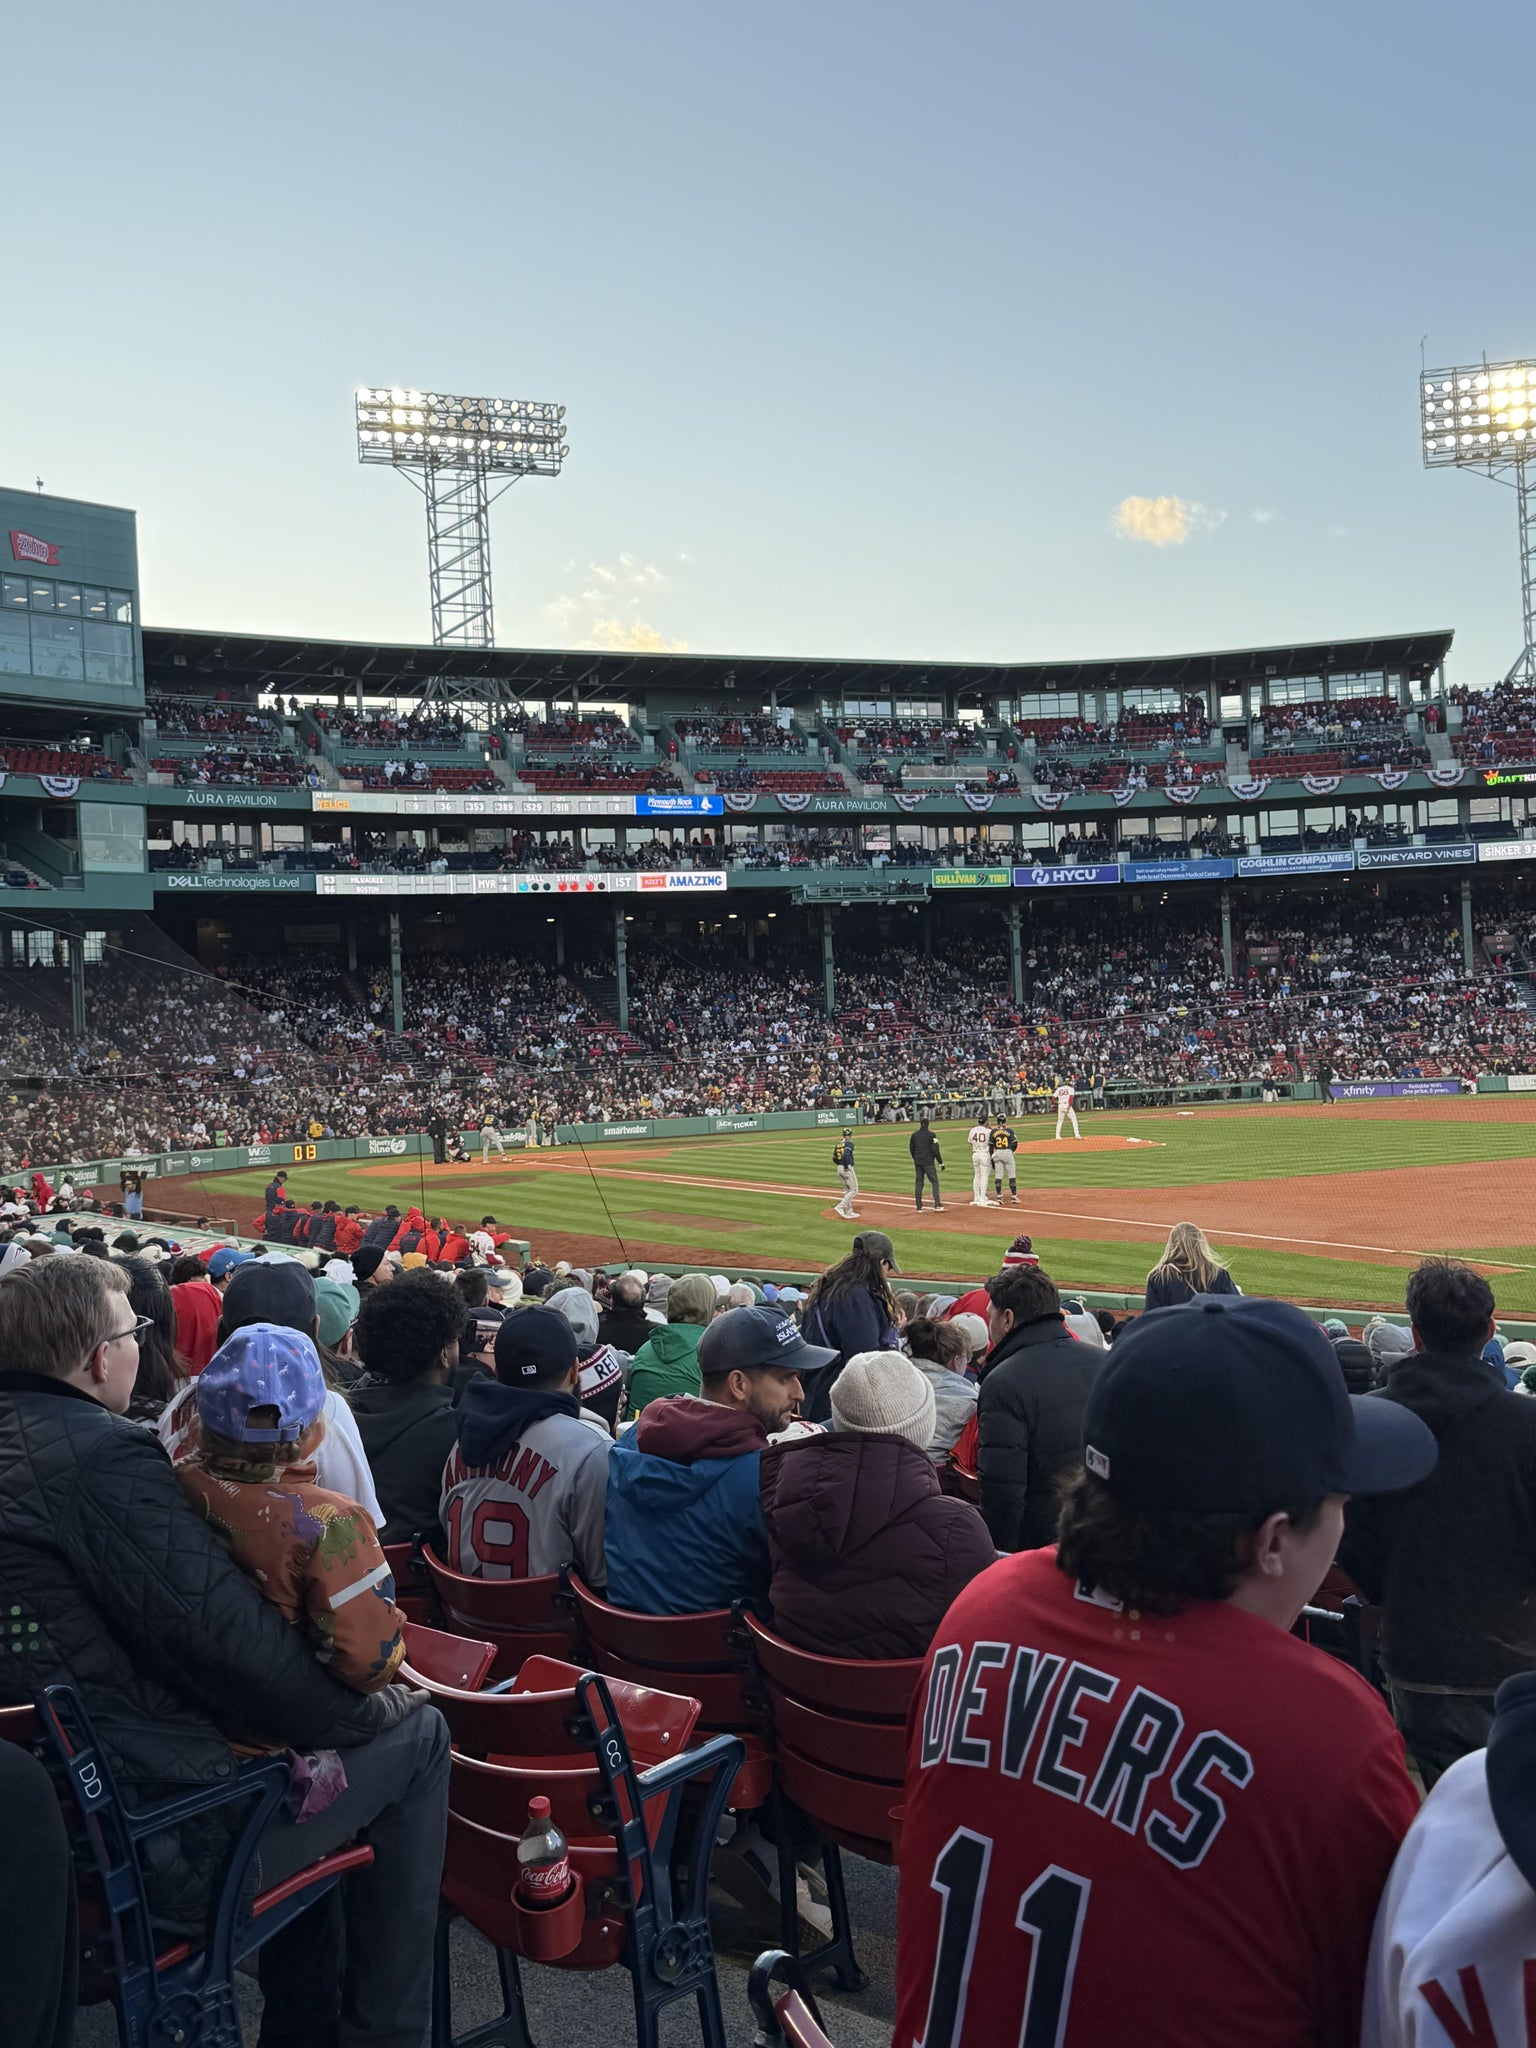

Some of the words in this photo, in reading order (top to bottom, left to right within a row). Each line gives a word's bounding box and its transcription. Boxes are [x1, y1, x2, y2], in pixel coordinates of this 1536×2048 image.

[1486, 773, 1536, 786] DRAFTKI
[227, 794, 277, 806] PAVILION
[317, 799, 350, 811] YELICH
[846, 801, 887, 810] PAVILION
[413, 803, 419, 811] 9
[440, 803, 451, 811] 36
[524, 803, 542, 811] .529
[553, 803, 569, 811] .918
[1371, 851, 1433, 863] VINEYARD
[1434, 849, 1471, 858] VINES
[1485, 846, 1521, 857] SINKER
[1240, 858, 1287, 869] COGHLIN
[1287, 853, 1352, 866] COMPANIES
[324, 876, 335, 884] 53
[350, 876, 384, 884] MILWAUKEE
[669, 875, 723, 887] AMAZING
[935, 871, 977, 884] SULLIVAN
[989, 873, 1008, 883] TIRE
[1052, 869, 1098, 882] HYCU
[168, 876, 202, 888] DELL
[202, 876, 271, 890] Technologies
[272, 876, 300, 888] Level
[478, 879, 496, 889] MVR
[1343, 1085, 1375, 1096] xfinity
[604, 1125, 648, 1136] smartwater
[732, 1120, 758, 1129] TICKET
[368, 1139, 391, 1148] Ninety
[972, 1133, 986, 1143] 40
[995, 1136, 1009, 1148] 24
[369, 1145, 391, 1154] Nine
[447, 1496, 530, 1578] 19
[606, 1739, 622, 1768] CC
[920, 1641, 1255, 1870] DEVERS
[79, 1761, 102, 1799] DD
[521, 1856, 568, 1886] Coca-Cola
[912, 1825, 1092, 2048] 11
